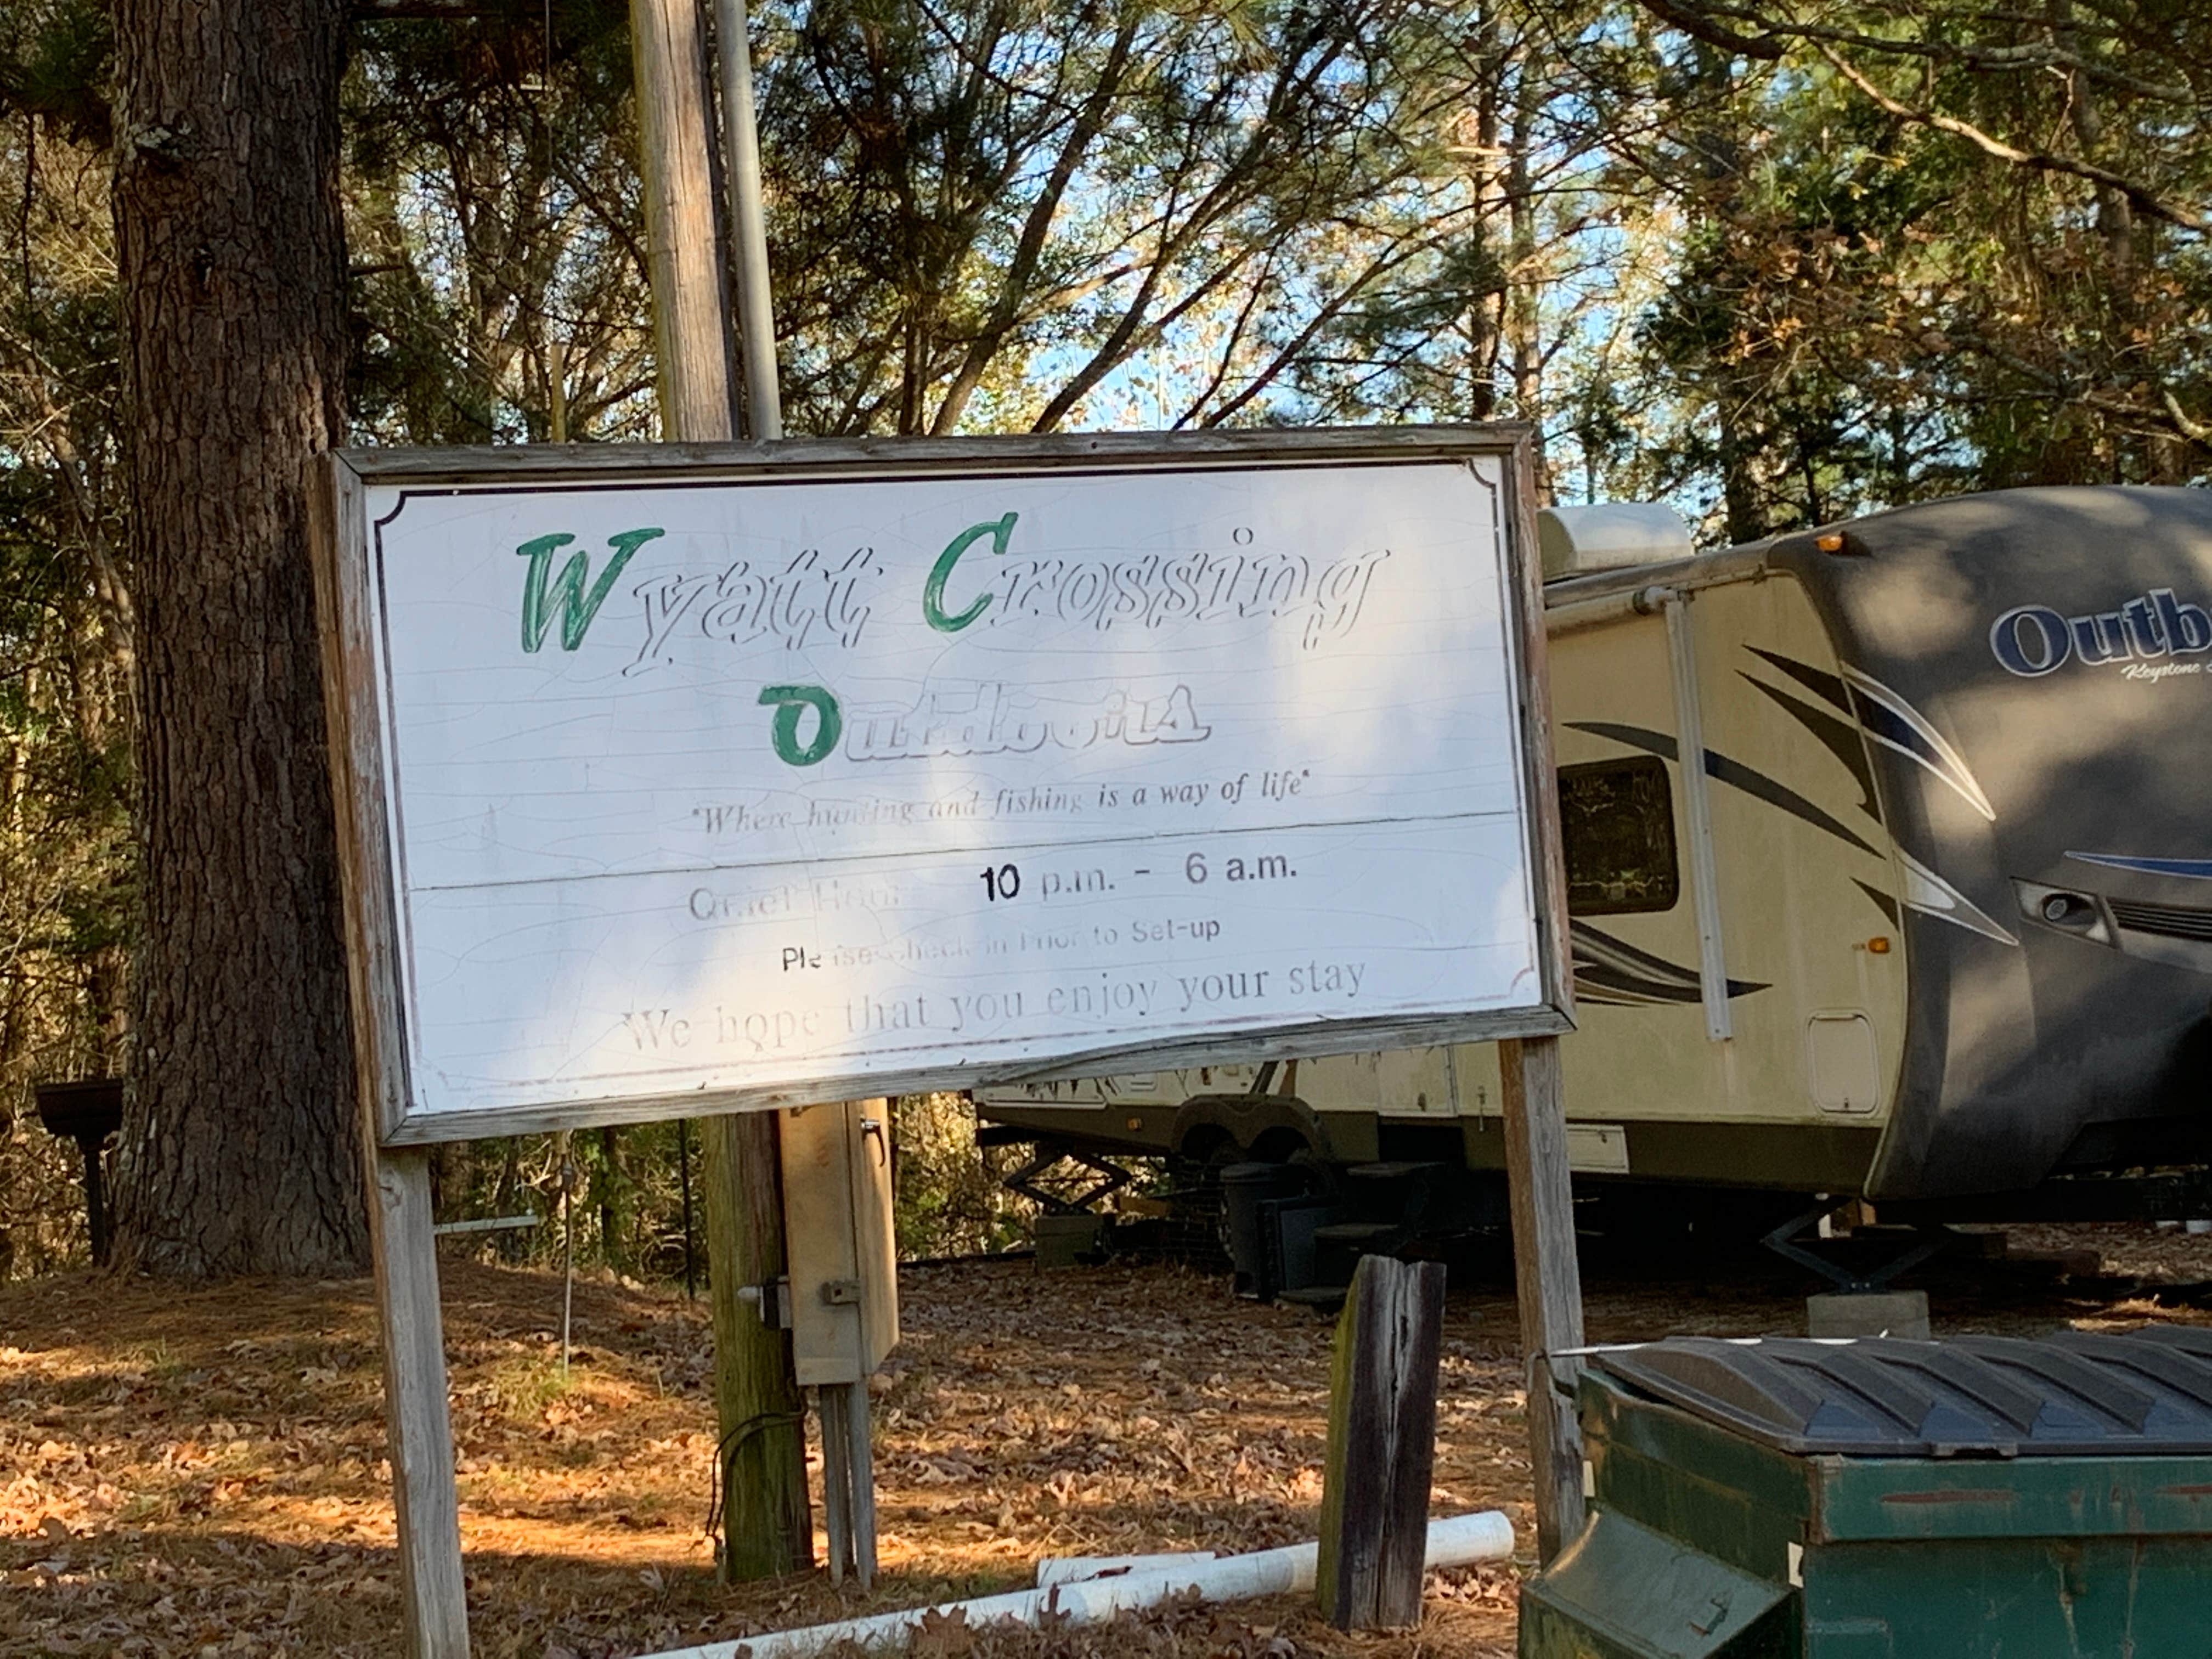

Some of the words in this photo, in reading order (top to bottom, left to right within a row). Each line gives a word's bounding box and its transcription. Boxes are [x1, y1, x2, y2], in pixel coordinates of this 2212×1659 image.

[517, 527, 883, 677] Wyatt
[923, 512, 1391, 650] Crossing
[1989, 588, 2212, 678] Outb
[2120, 662, 2201, 684] Keystone
[990, 788, 1083, 820] fishing
[1098, 783, 1118, 807] is
[1132, 788, 1147, 805] a
[1160, 781, 1209, 806] way
[1220, 773, 1250, 805] of
[979, 864, 1021, 901] 10
[1185, 851, 1207, 884] 6
[1226, 854, 1297, 882] a.m.
[1094, 926, 1118, 945] to
[1131, 918, 1221, 941] Set-up
[622, 1008, 692, 1050] We
[715, 1006, 820, 1052] hope
[845, 992, 929, 1031] that
[949, 991, 1023, 1032] you
[1047, 972, 1156, 1019] enjoy
[1178, 968, 1269, 1012] your
[1289, 958, 1366, 998] stay
